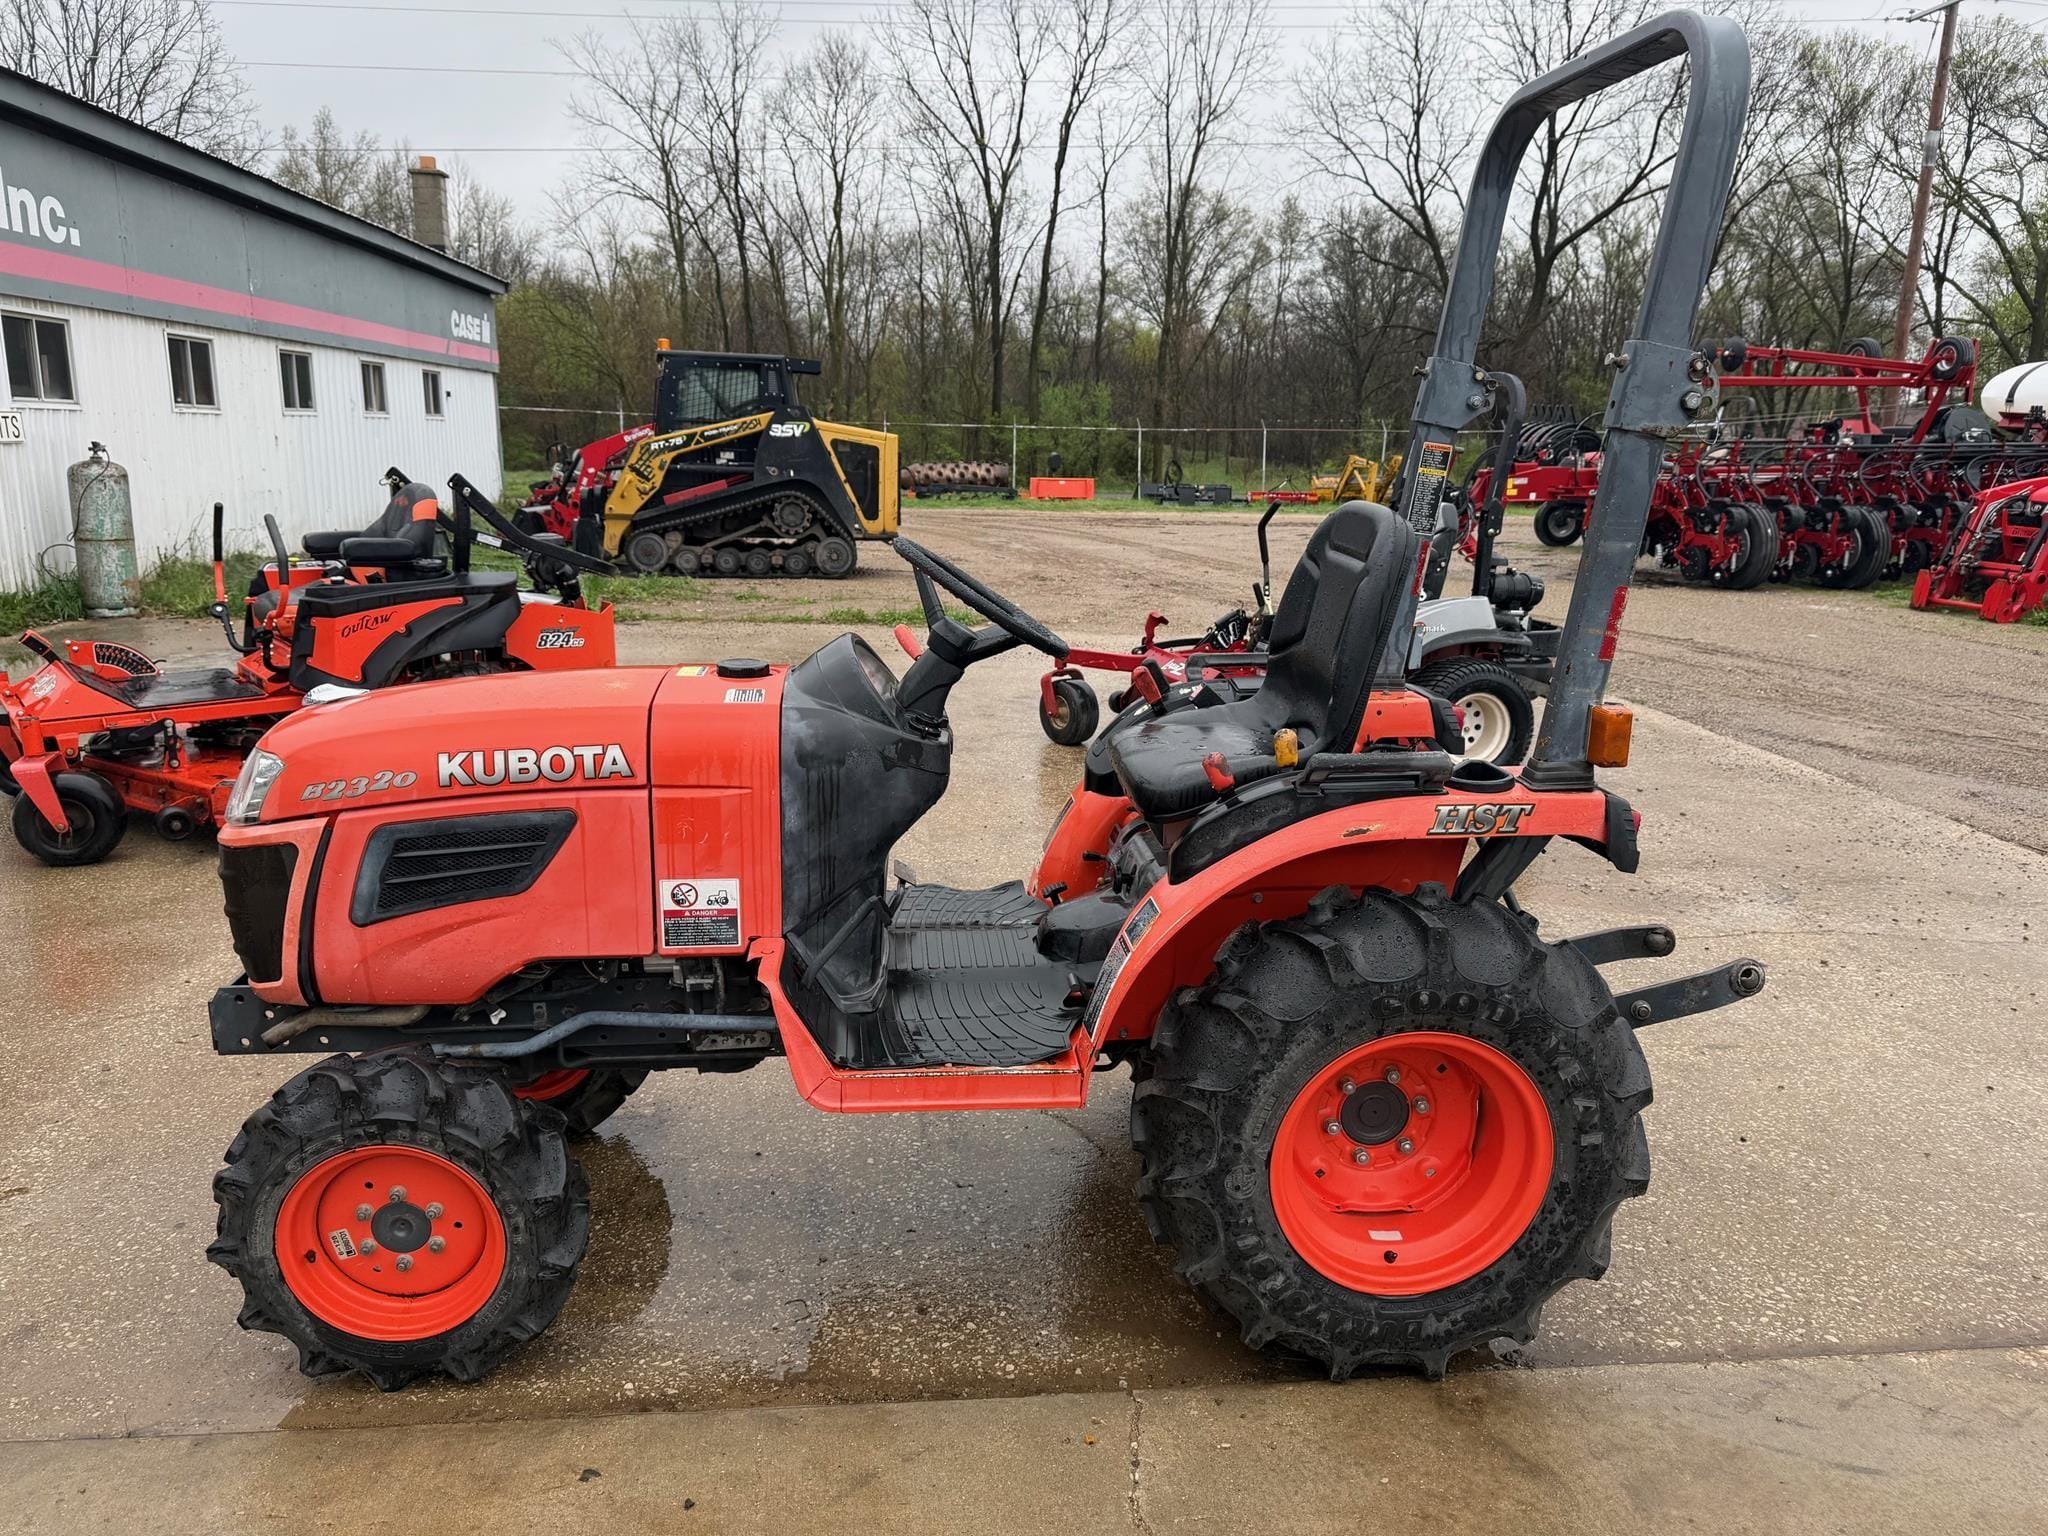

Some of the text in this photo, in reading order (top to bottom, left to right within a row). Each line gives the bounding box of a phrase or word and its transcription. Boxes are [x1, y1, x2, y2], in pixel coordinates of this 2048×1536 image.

[450, 309, 481, 342] CASE
[0, 415, 21, 439] TS
[650, 436, 683, 451] RT-75
[1423, 623, 1447, 633] mark
[437, 744, 635, 788] KUBOTA
[300, 770, 417, 802] B2320
[1427, 802, 1536, 835] HST
